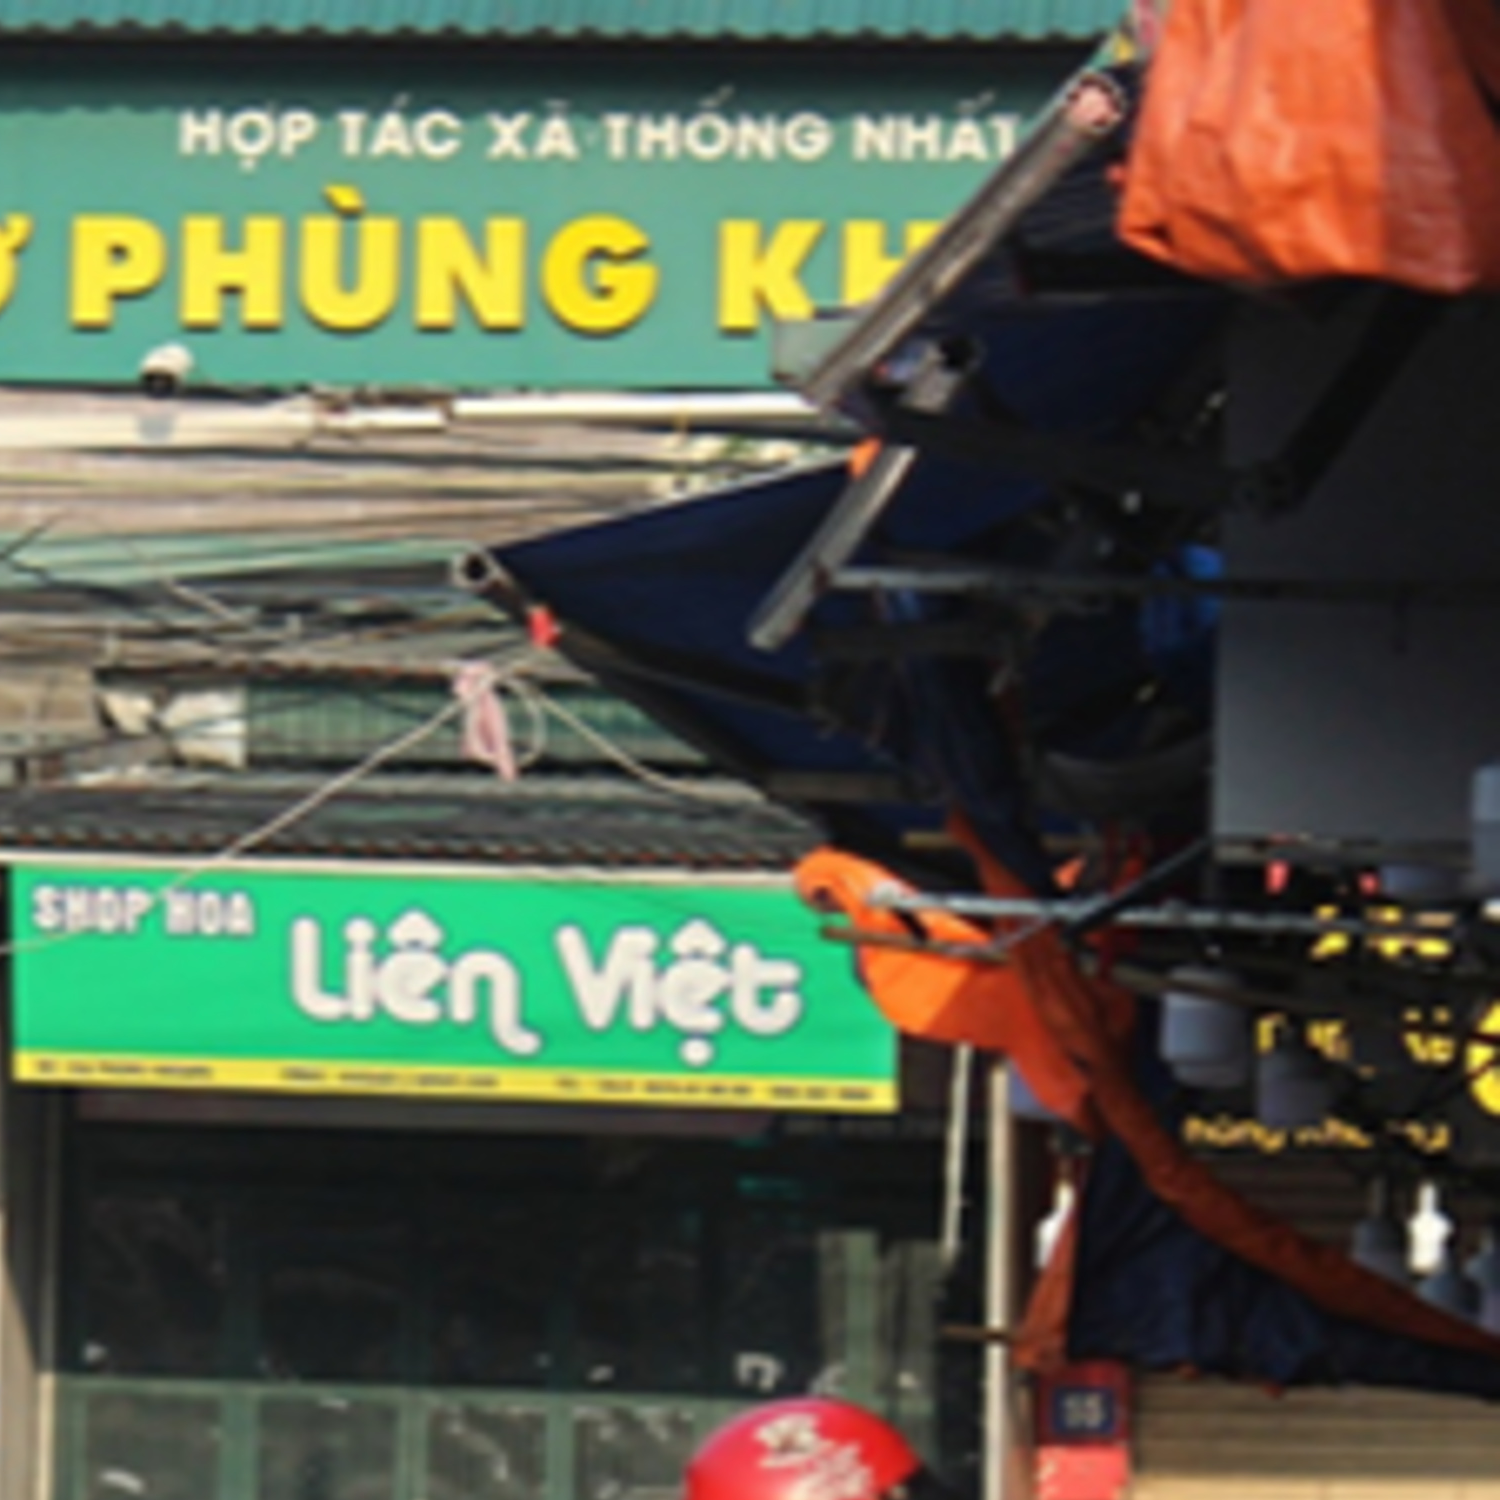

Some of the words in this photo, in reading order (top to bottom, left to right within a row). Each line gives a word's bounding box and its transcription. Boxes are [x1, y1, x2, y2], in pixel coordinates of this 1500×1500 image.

[180, 103, 317, 172] HỢP
[337, 94, 463, 159] TÁC
[486, 100, 579, 160] XÃ
[603, 84, 833, 162] THỐNG
[852, 91, 1020, 161] NHẤT
[68, 184, 660, 338] PHÙNG
[32, 884, 153, 934] SHOP
[164, 887, 256, 936] HOA
[291, 910, 542, 1057] Liên
[554, 917, 801, 1067] Việt
